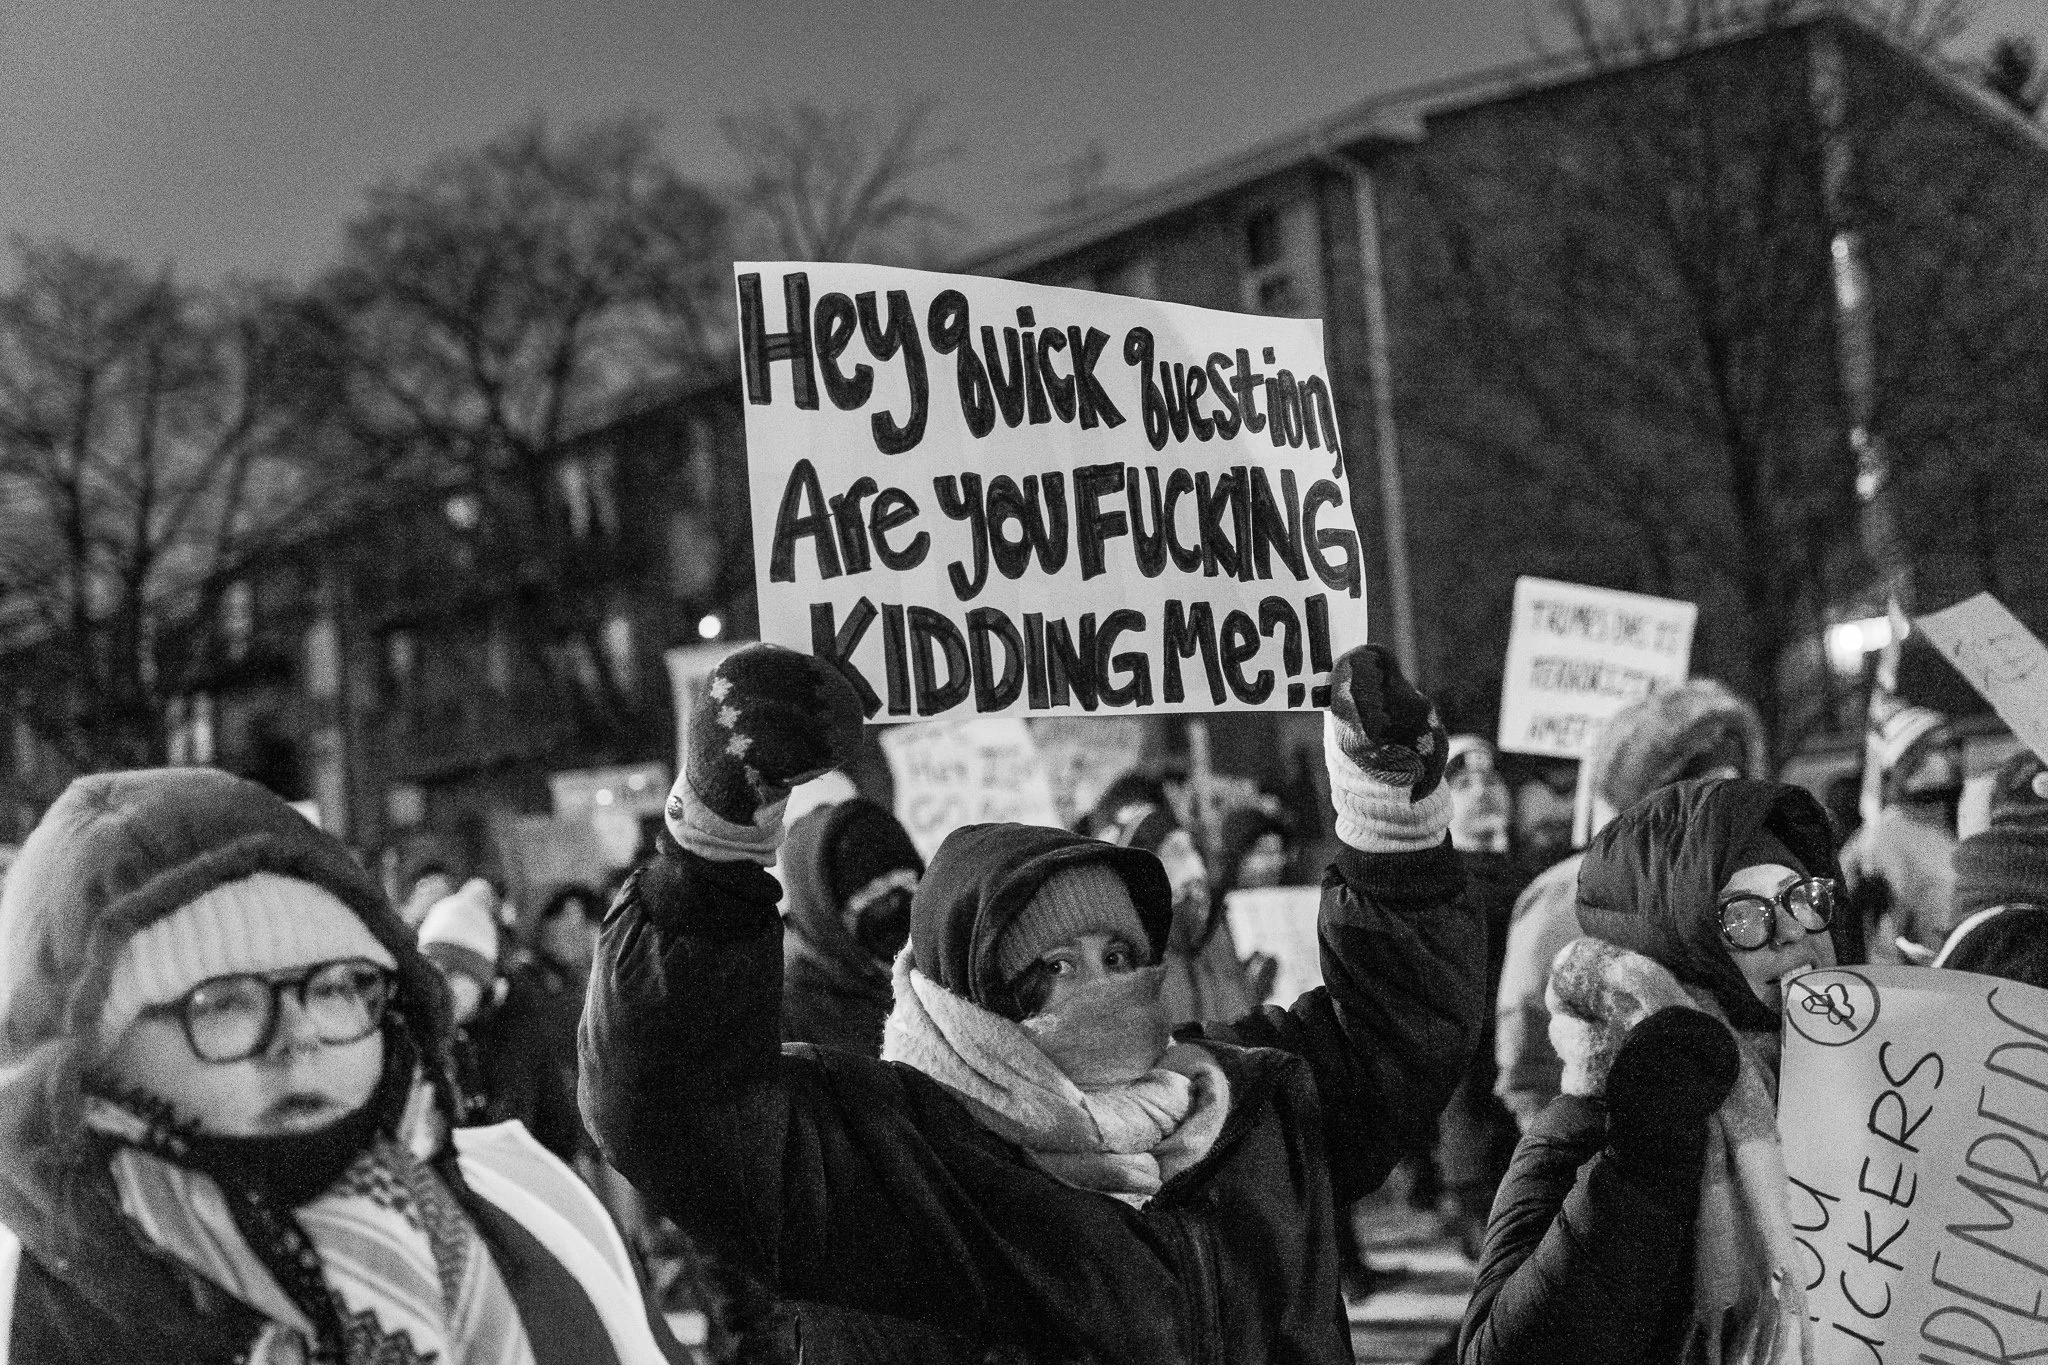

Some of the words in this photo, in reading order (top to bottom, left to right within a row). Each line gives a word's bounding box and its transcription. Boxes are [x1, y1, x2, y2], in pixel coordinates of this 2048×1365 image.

[738, 271, 929, 455] Hey
[769, 458, 931, 584] Are
[1075, 461, 1362, 600] FUCKING
[809, 596, 1154, 721] KIDDING
[1162, 593, 1334, 708] Me?!
